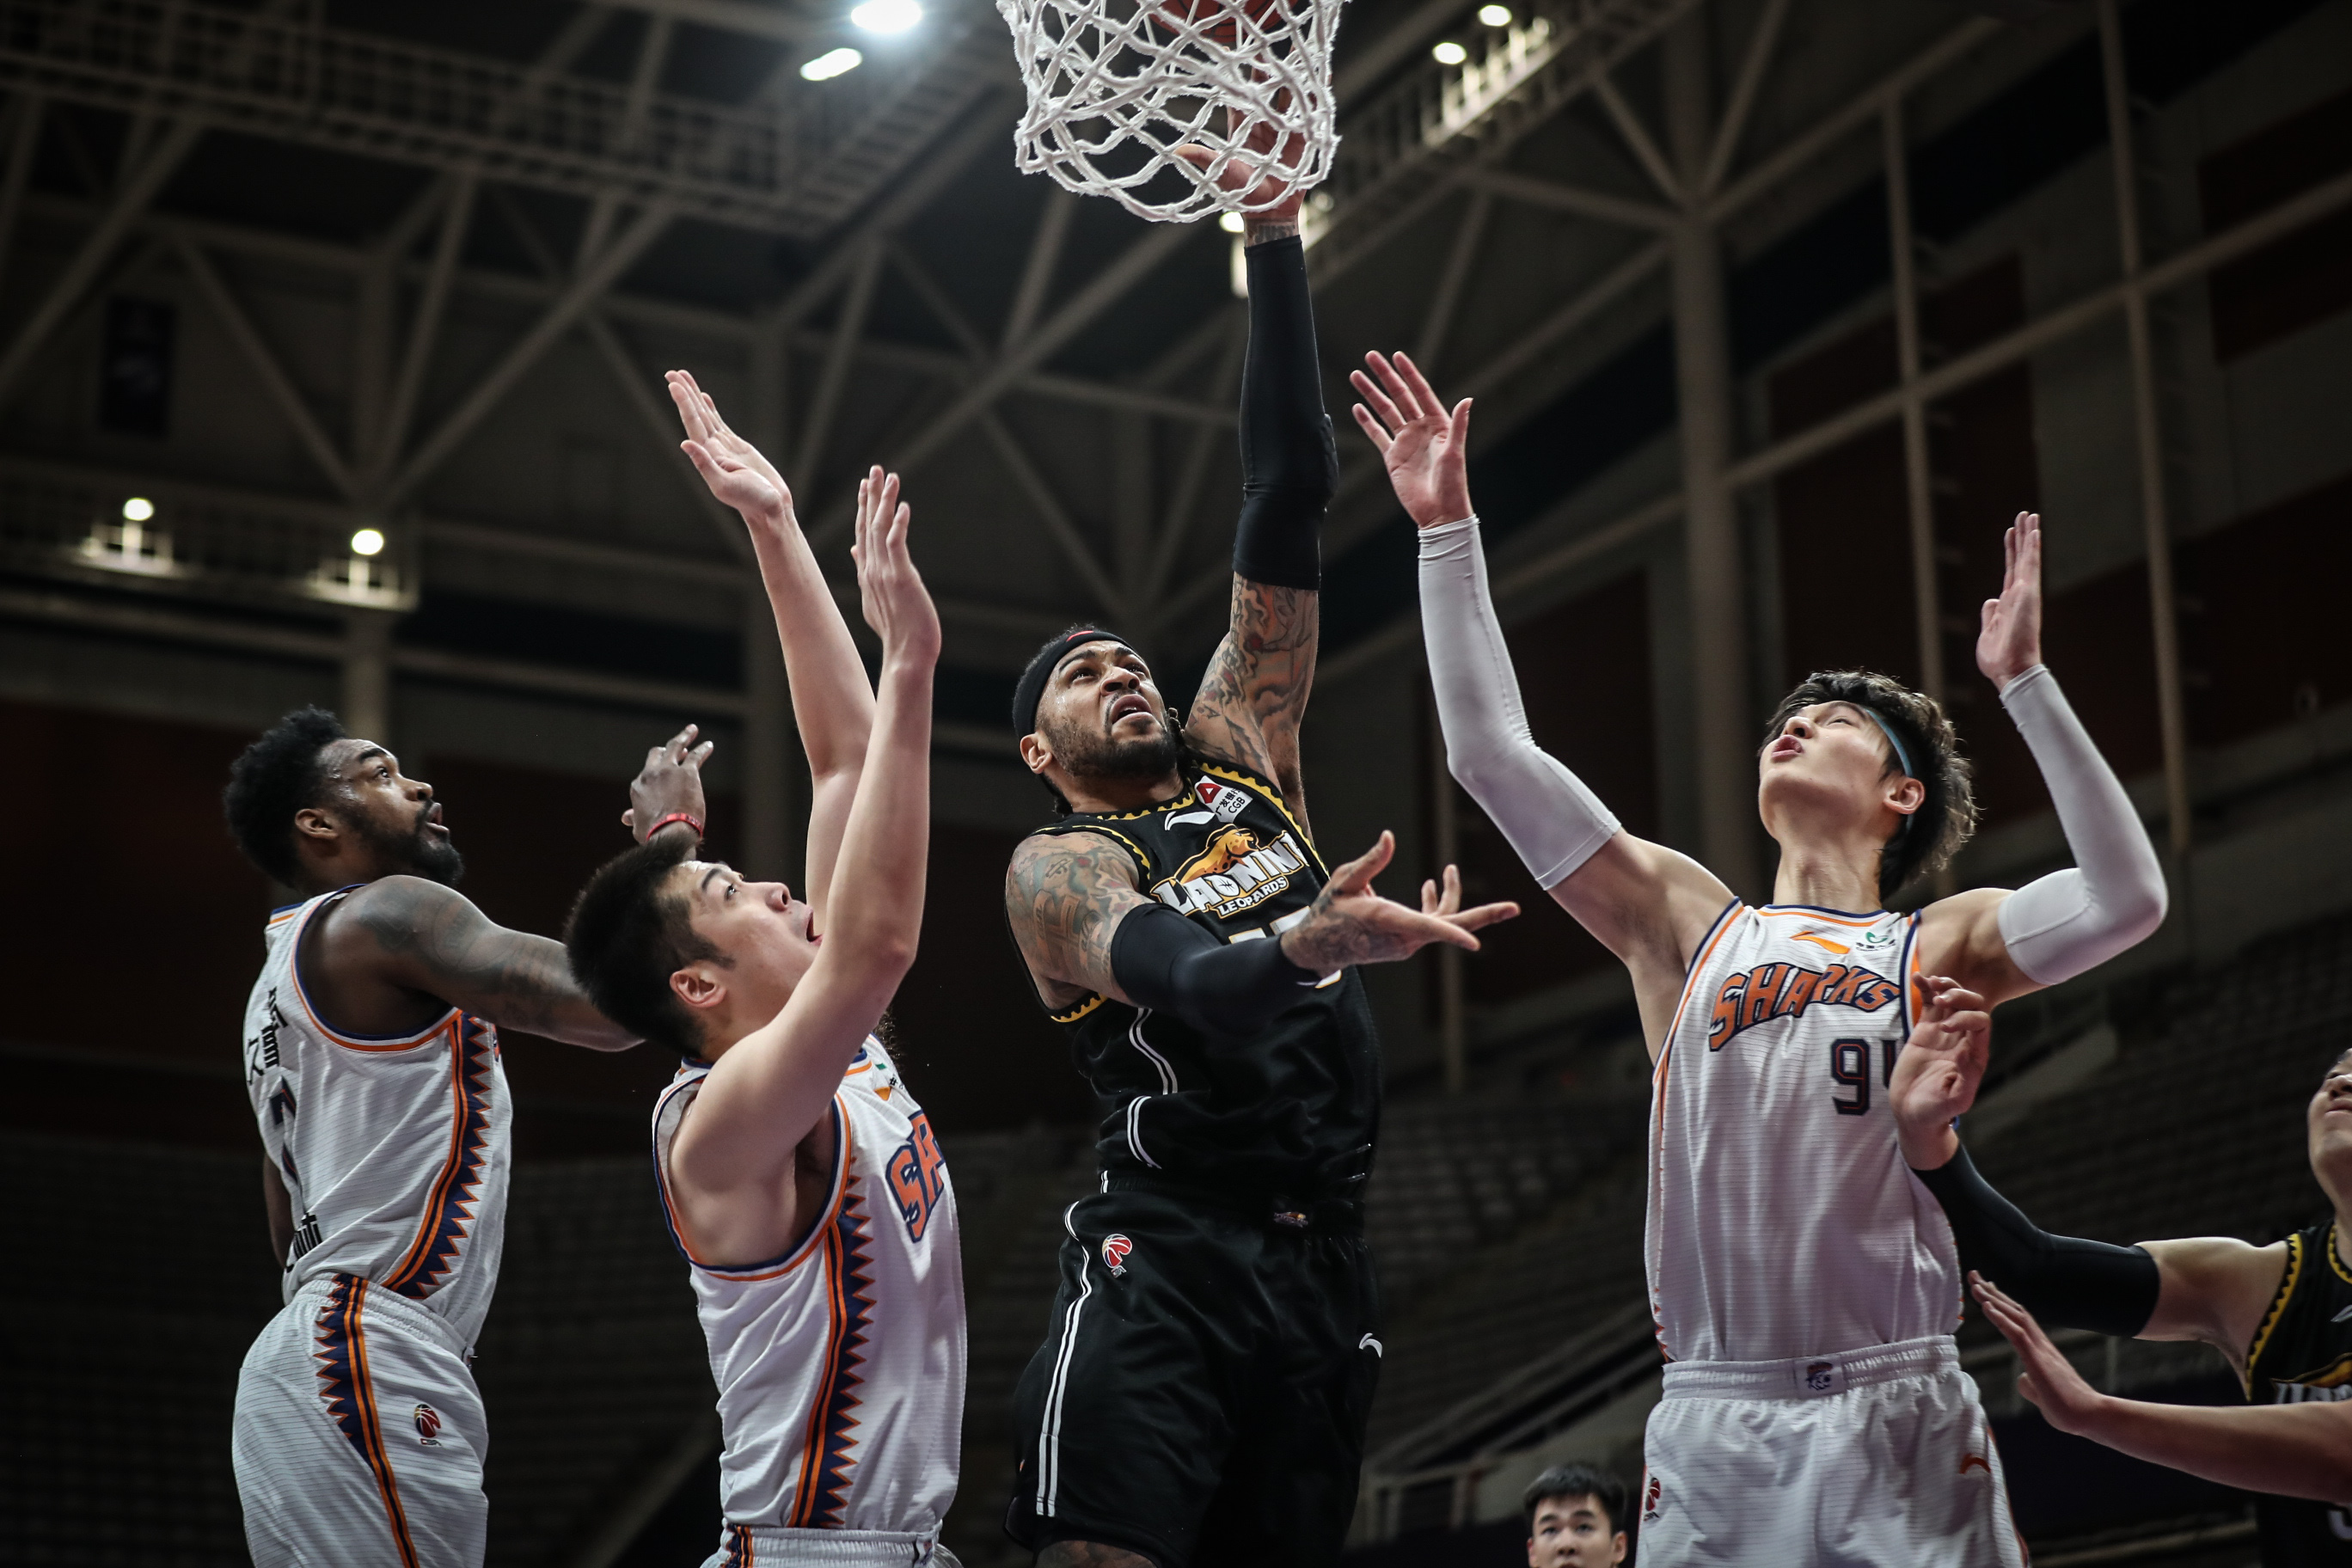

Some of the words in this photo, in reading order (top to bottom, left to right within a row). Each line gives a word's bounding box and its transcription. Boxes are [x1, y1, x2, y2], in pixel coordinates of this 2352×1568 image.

[1228, 797, 1246, 813] CGB
[1217, 877, 1287, 916] LEOPARDS
[1708, 961, 1902, 1052] SHARKS
